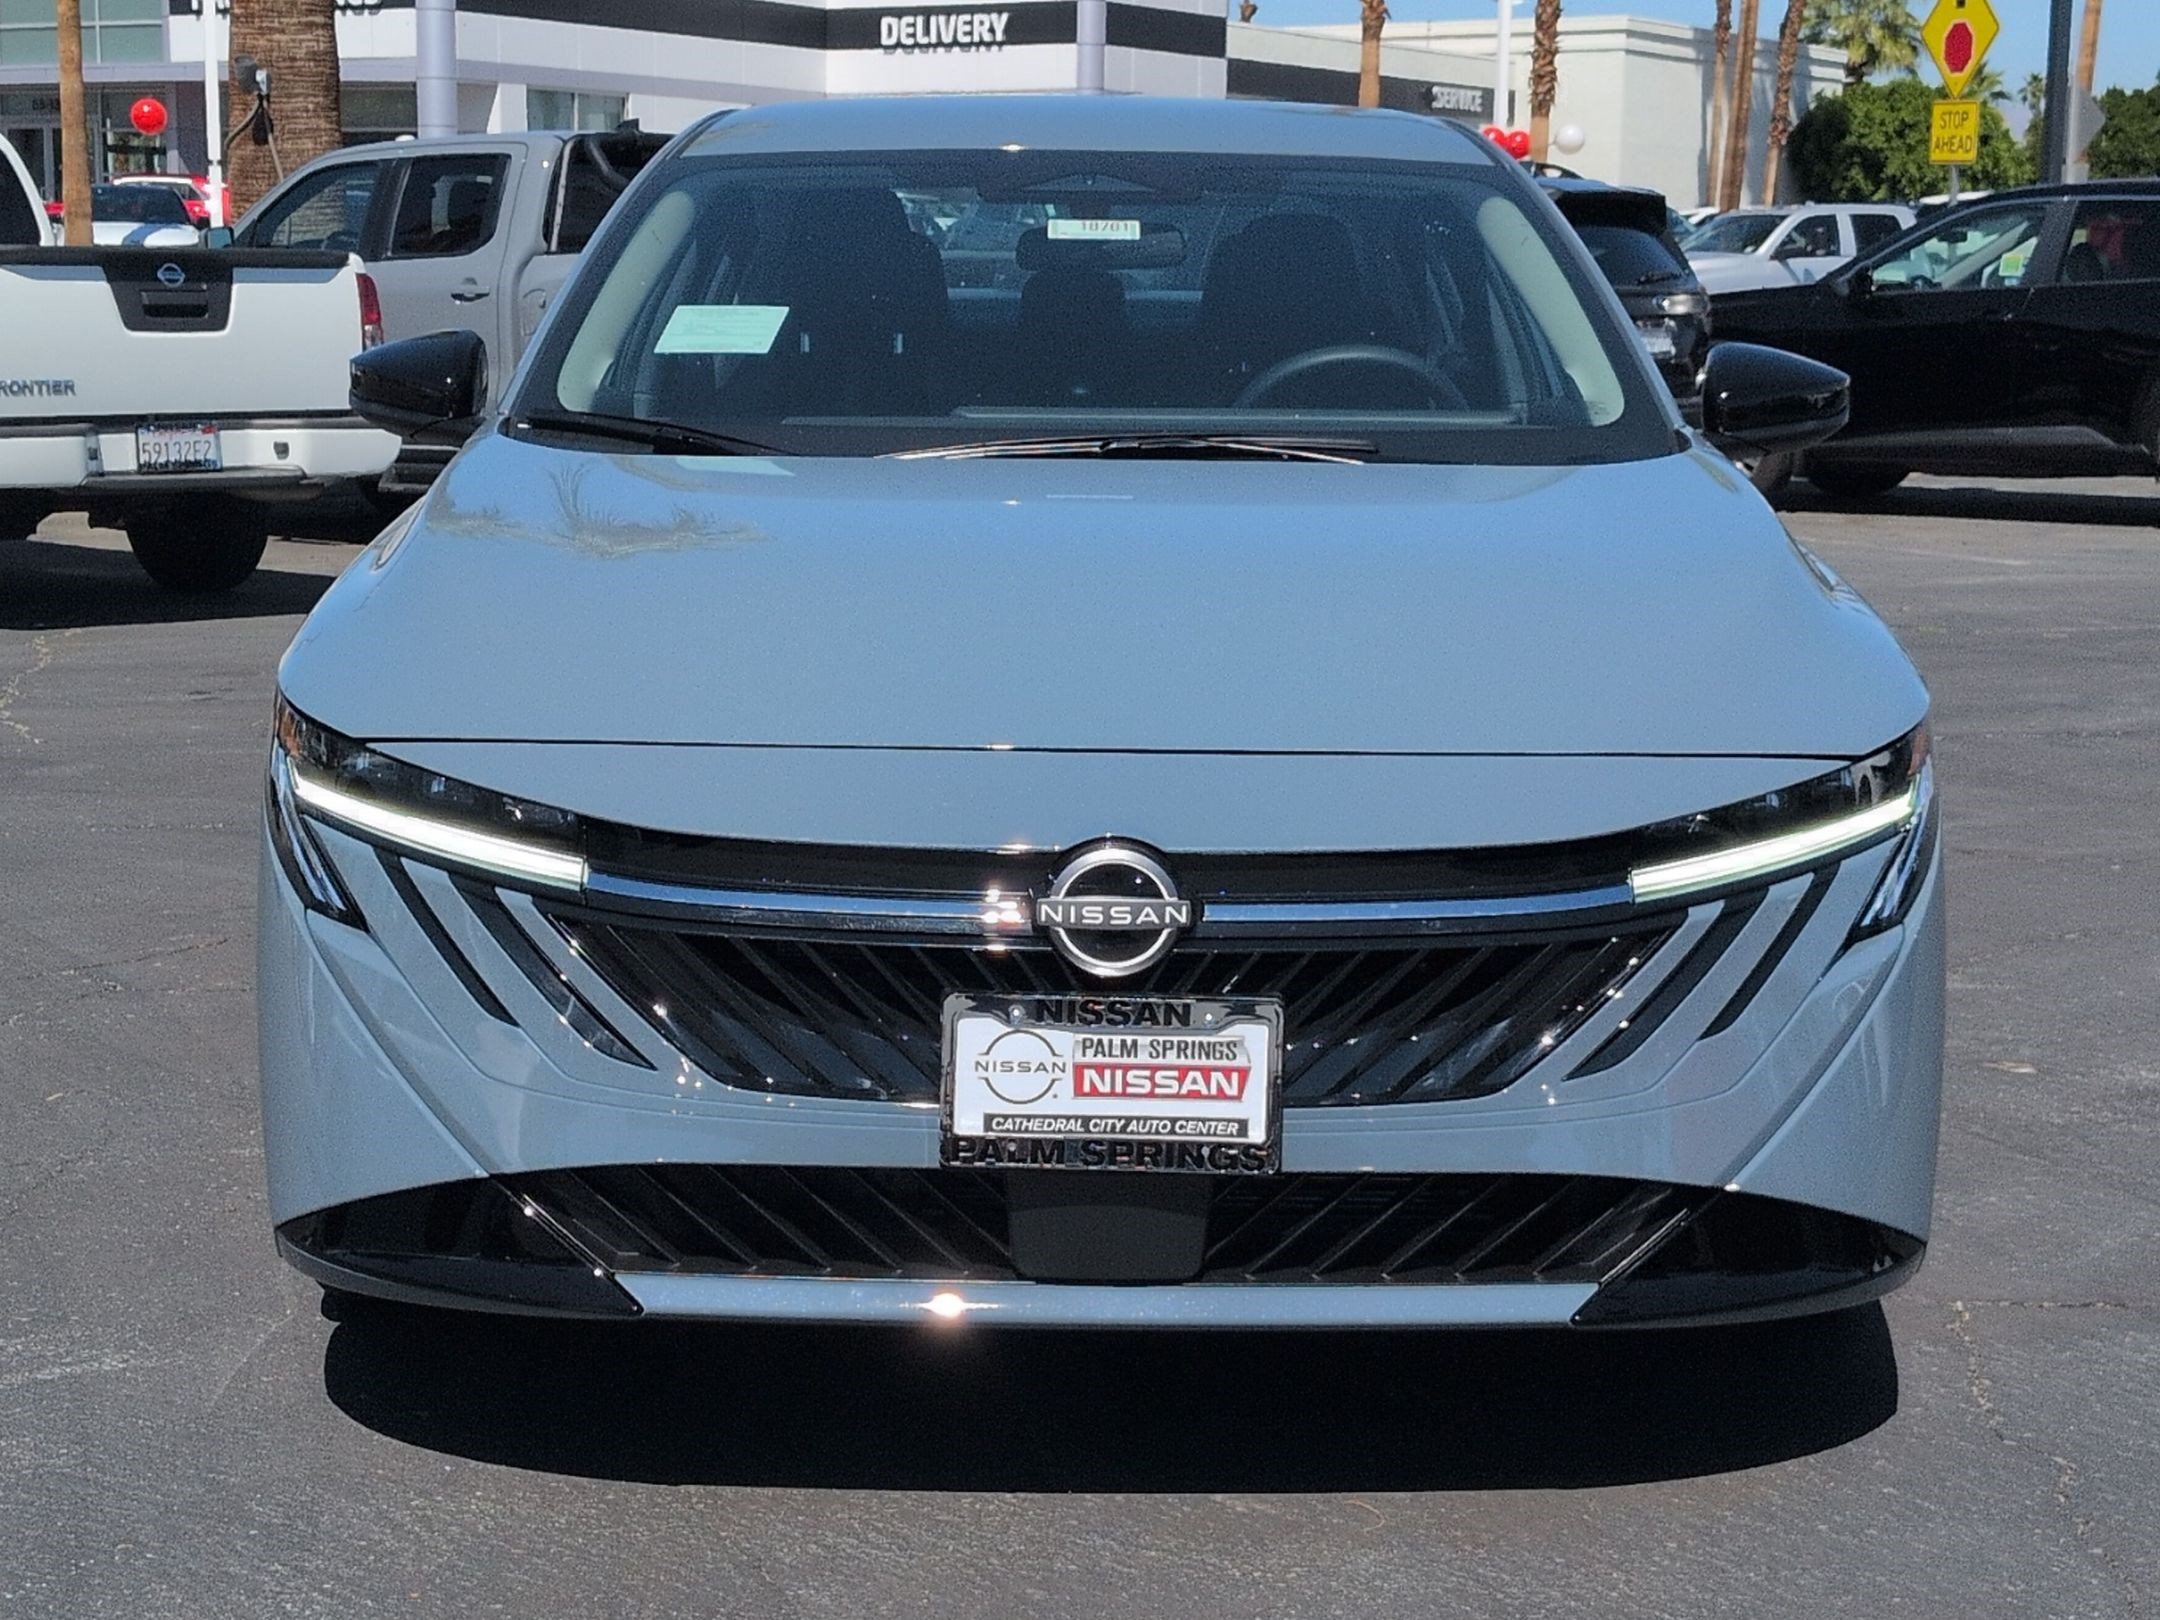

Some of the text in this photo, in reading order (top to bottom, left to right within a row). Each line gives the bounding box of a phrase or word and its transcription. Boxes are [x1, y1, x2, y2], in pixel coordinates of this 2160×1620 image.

[880, 12, 1009, 46] DELIVERY
[1431, 85, 1482, 112] SERVICE
[1940, 110, 1969, 129] STOP
[1934, 135, 1973, 153] AHEAD
[1040, 904, 1187, 925] NISSAN
[1034, 1000, 1191, 1027] NISSAN
[1081, 1037, 1238, 1061] PALM SPRINGS
[975, 1060, 1066, 1074] NISSAN
[1082, 1068, 1239, 1097] NISSAN
[991, 1116, 1239, 1136] CATHEDRAL CITY AUTO CENTER
[954, 1138, 1269, 1172] PALM SPRINGS
